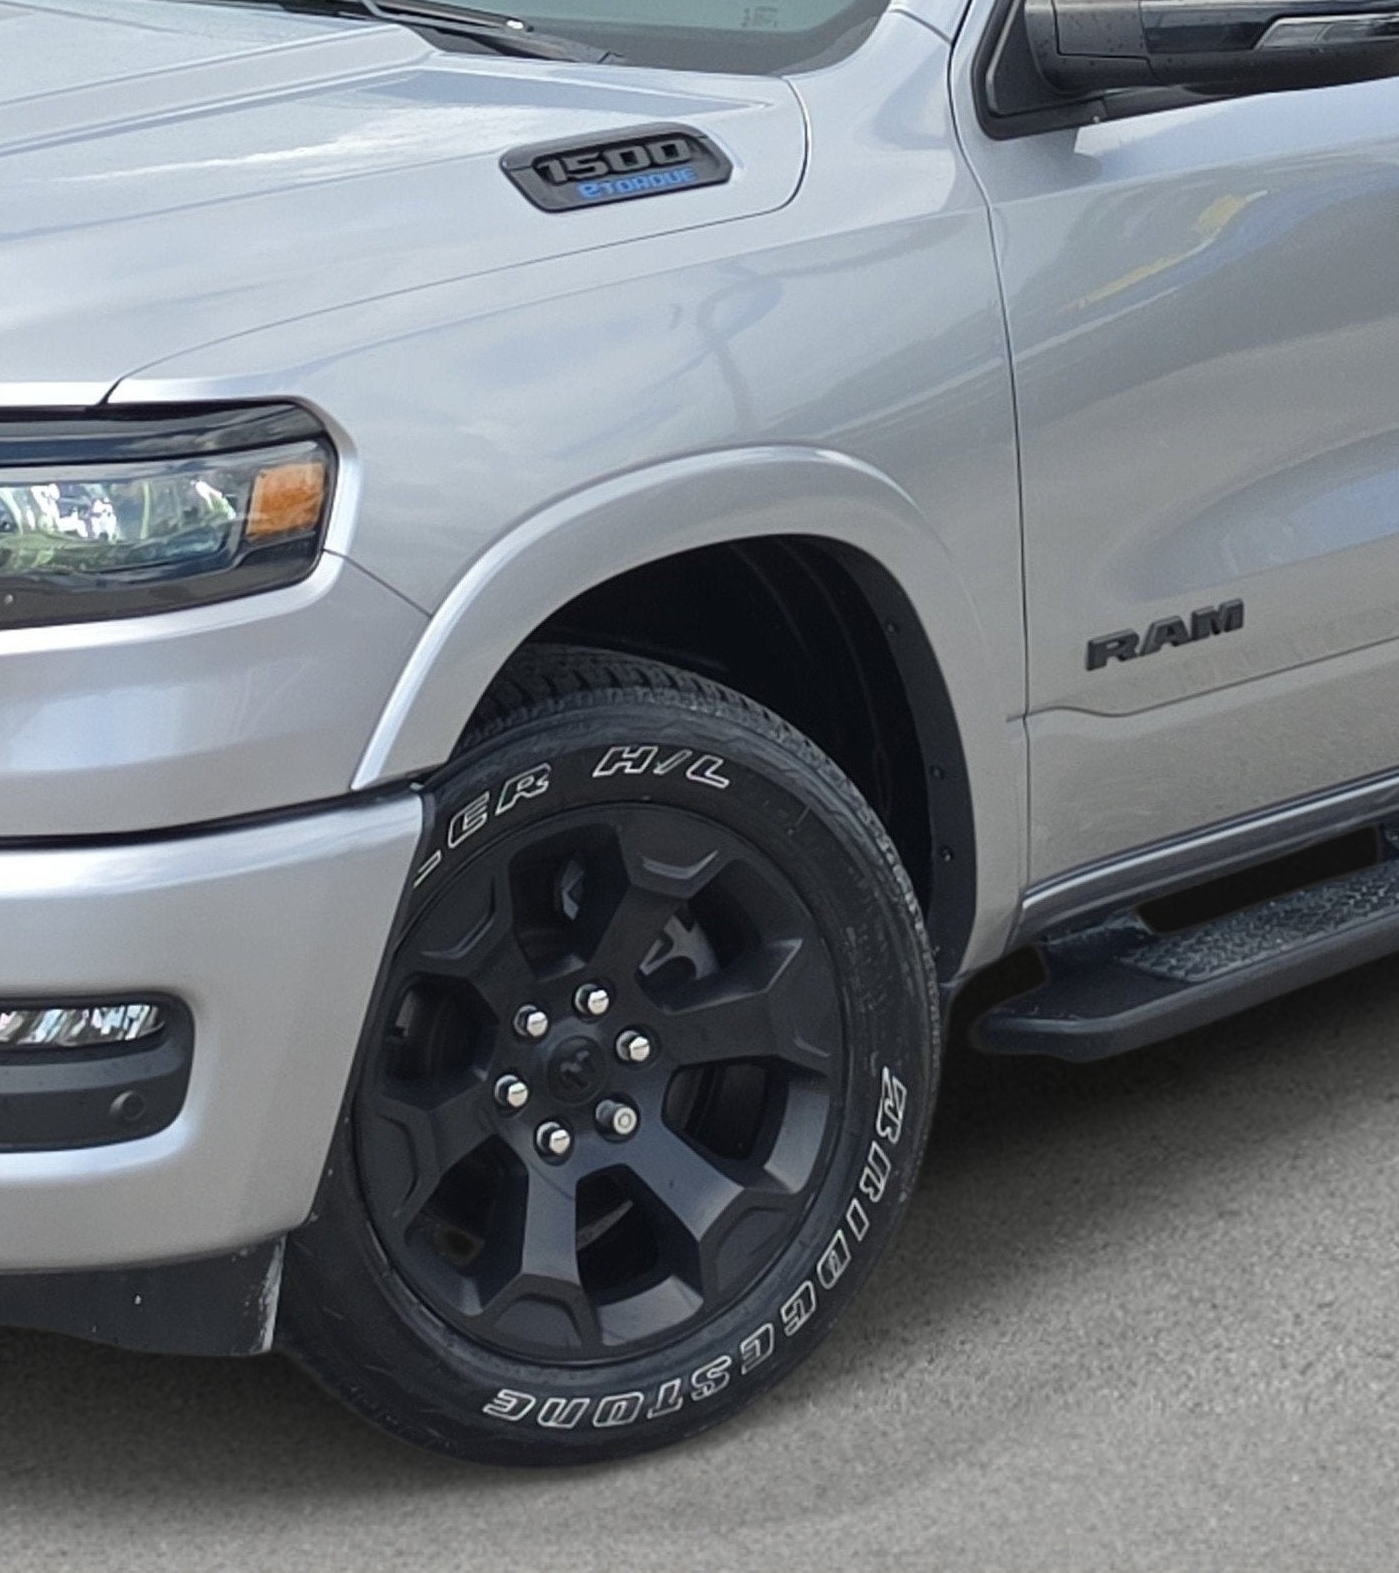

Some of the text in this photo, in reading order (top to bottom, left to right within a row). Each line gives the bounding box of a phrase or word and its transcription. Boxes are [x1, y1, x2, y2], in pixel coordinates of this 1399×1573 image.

[535, 137, 693, 186] 1500
[1085, 597, 1245, 672] RAM
[592, 744, 731, 791] H/L
[482, 1065, 907, 1429] BRIDGESTONE
